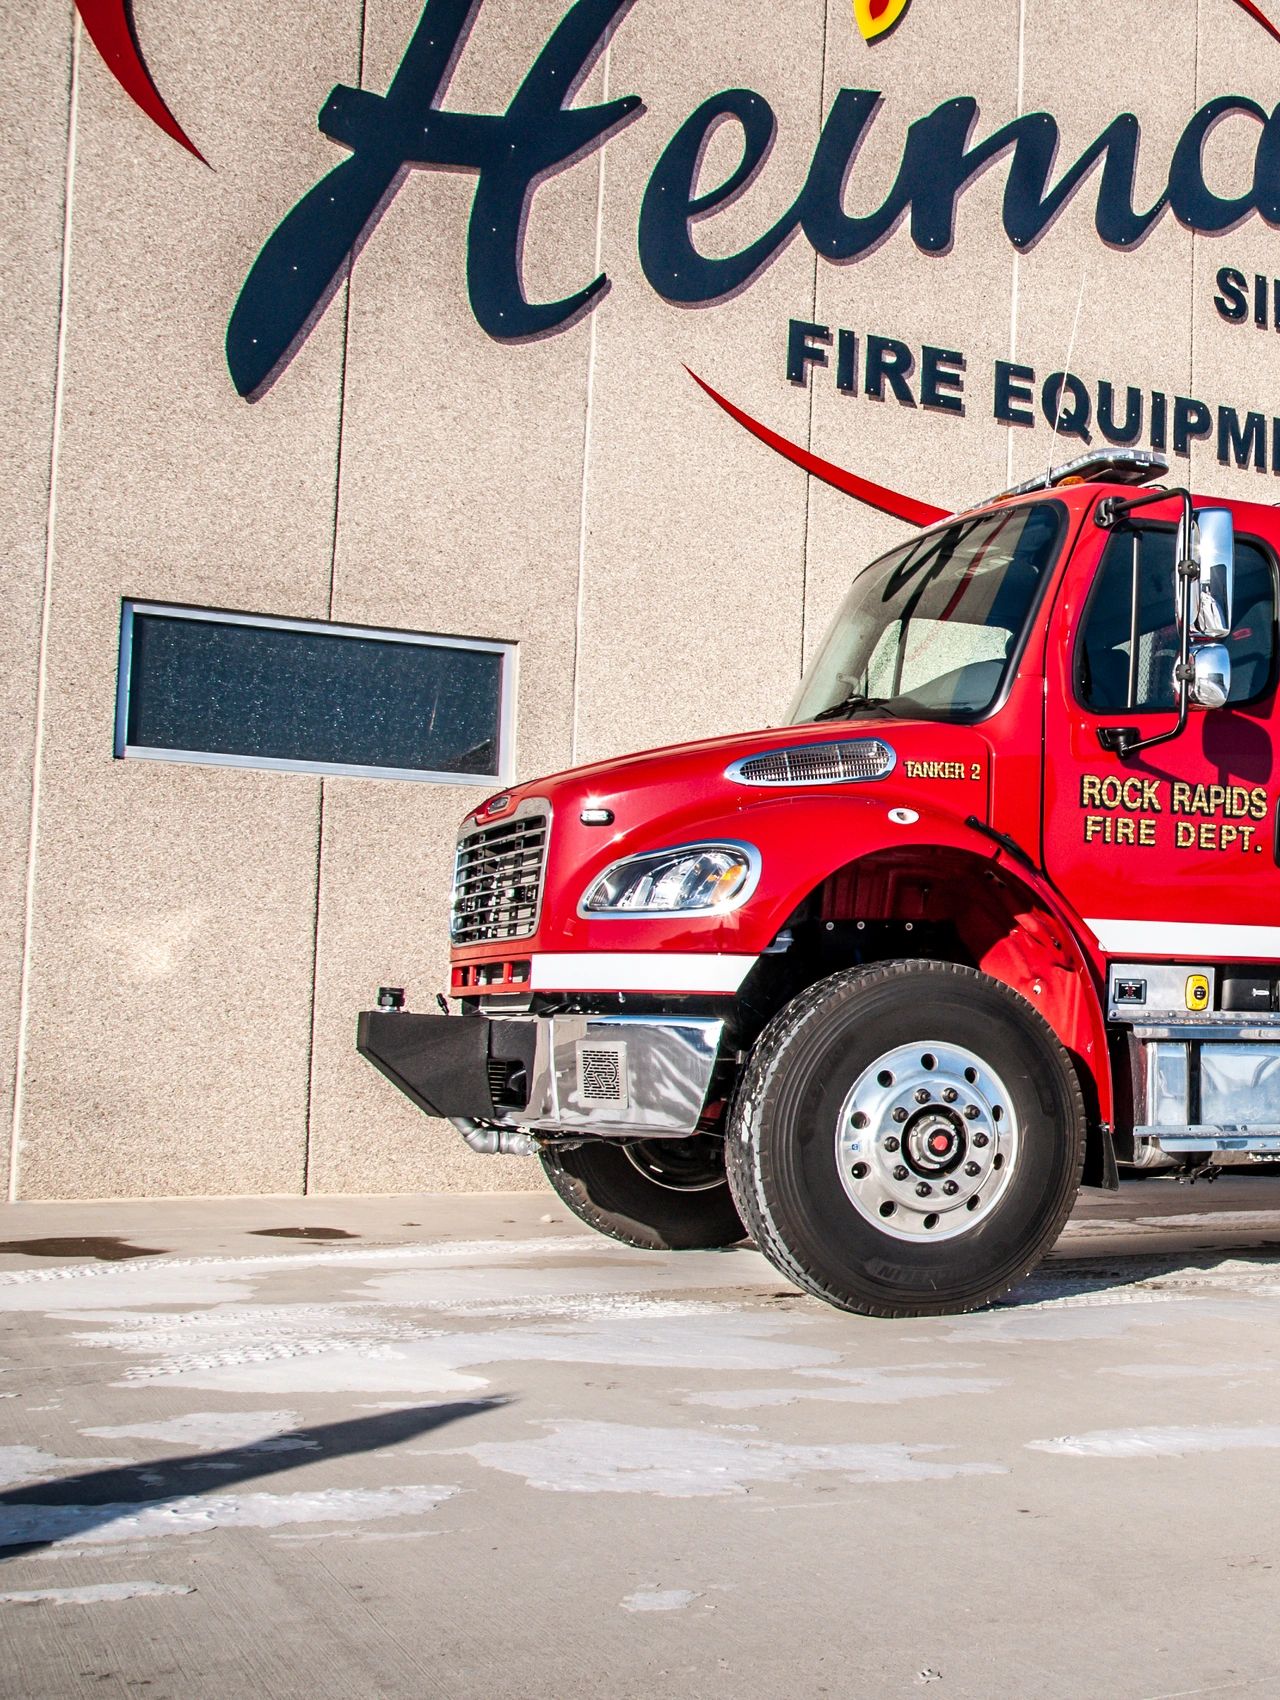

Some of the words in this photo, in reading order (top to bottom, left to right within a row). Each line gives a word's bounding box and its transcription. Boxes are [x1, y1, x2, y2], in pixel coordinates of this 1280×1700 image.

[786, 319, 965, 413] FIRE
[903, 760, 966, 779] TANKER
[970, 763, 981, 780] 2
[1080, 774, 1162, 813] ROCK
[1171, 781, 1268, 819] RAPIDS
[1085, 815, 1157, 845] FIRE
[1175, 821, 1263, 853] DEPT.
